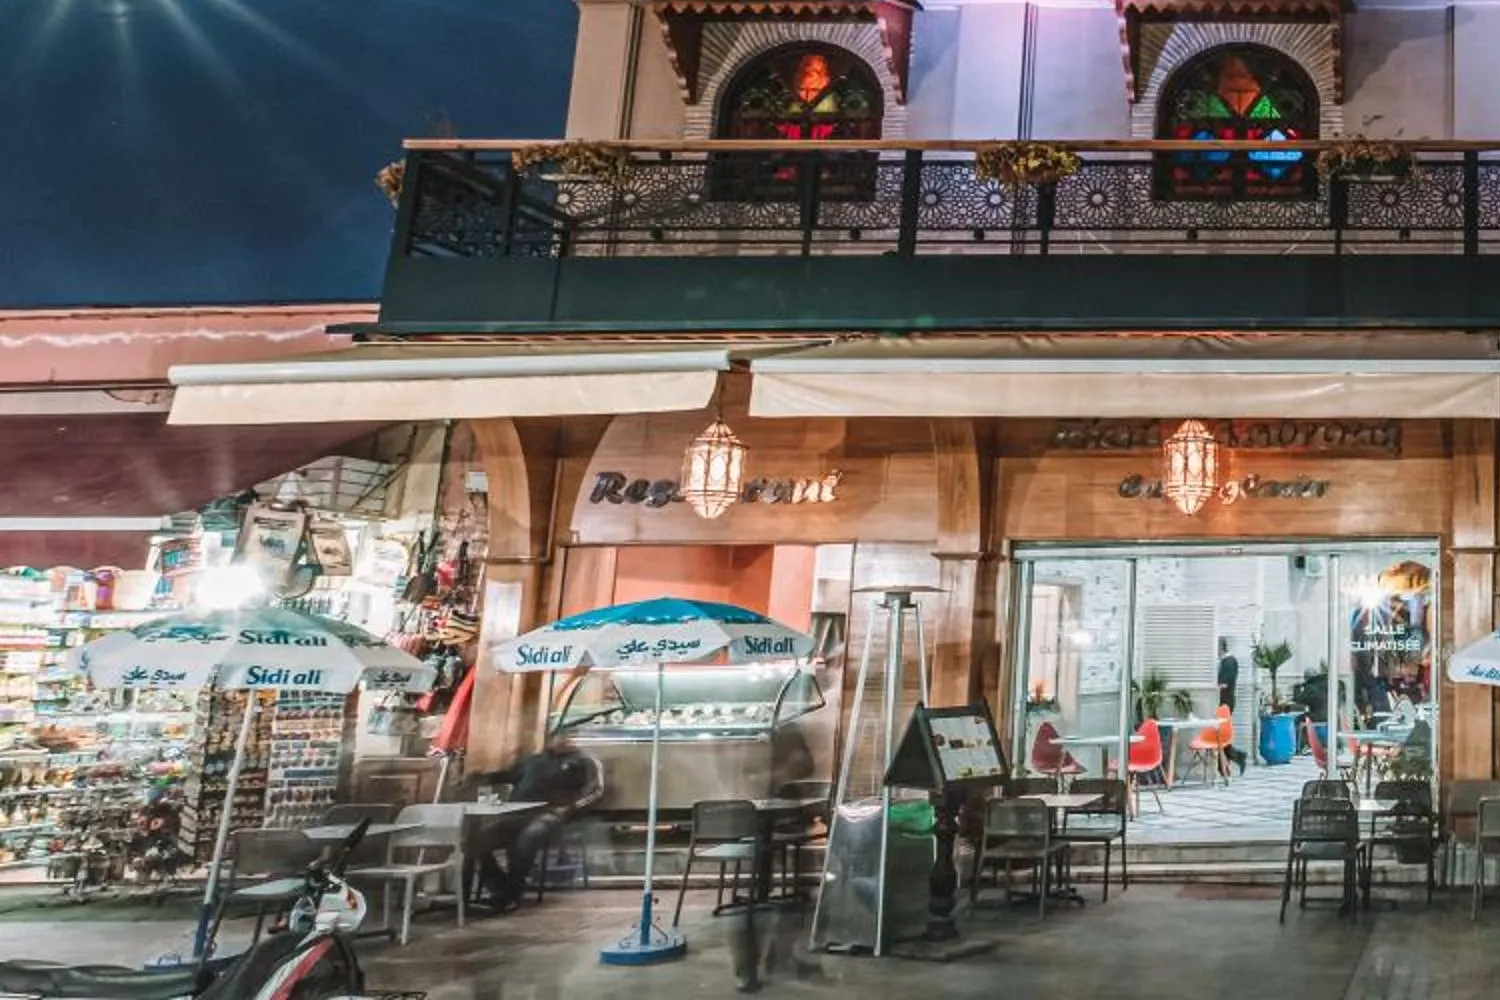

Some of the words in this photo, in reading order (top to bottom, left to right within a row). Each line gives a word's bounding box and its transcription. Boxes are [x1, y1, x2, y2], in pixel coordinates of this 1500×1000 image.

[237, 629, 290, 647] Sidi
[293, 632, 328, 647] ali
[516, 644, 549, 666] Sidi
[550, 645, 572, 664] ali
[245, 664, 289, 686] Sidi
[292, 668, 321, 686] ali
